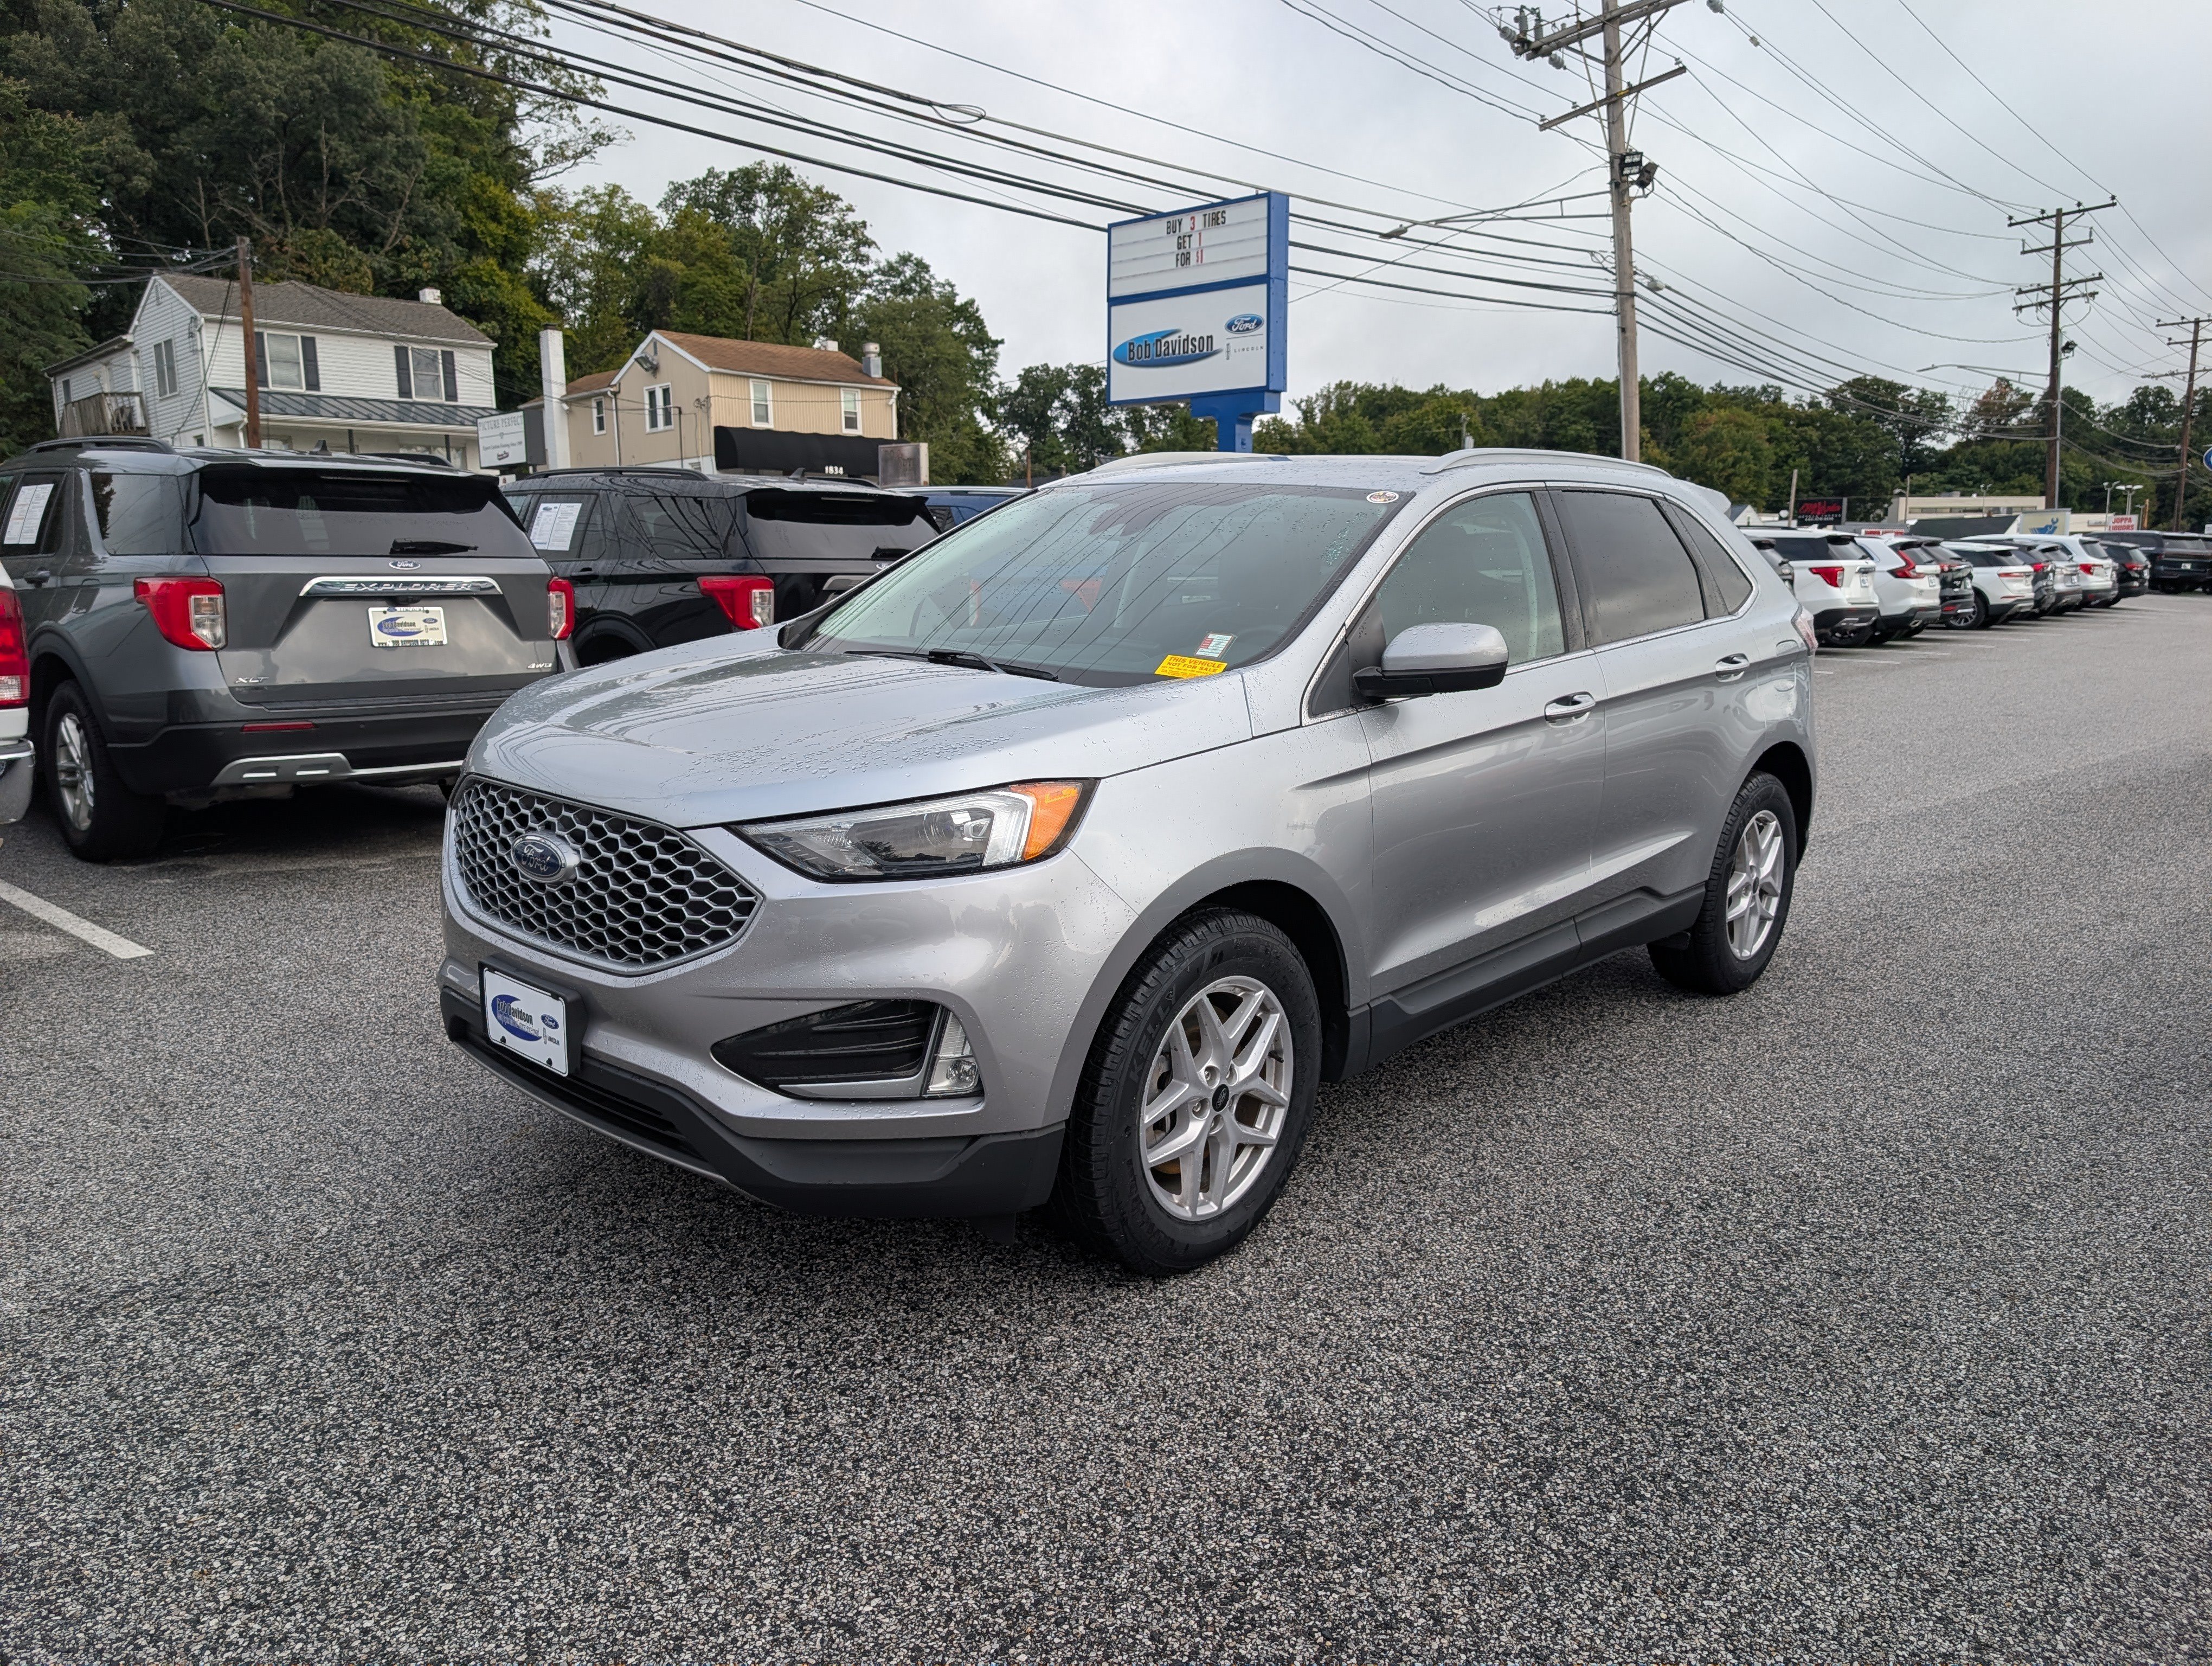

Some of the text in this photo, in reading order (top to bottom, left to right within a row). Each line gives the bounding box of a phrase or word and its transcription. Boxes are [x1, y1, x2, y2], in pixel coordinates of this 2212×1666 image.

[1166, 210, 1226, 235] BUY 3 TIRES
[1177, 232, 1202, 250] GET 1
[1175, 251, 1191, 267] FOR
[1231, 317, 1257, 331] Ford
[1128, 334, 1214, 362] Bob Davidson
[825, 465, 844, 475] 1834
[339, 582, 471, 591] EXPLORER
[1189, 659, 1224, 669] VEHICLE
[520, 844, 551, 872] Ford
[497, 998, 507, 1015] Bob
[508, 1003, 533, 1025] Davidson
[544, 1016, 556, 1028] Ford
[1129, 984, 1176, 1084] KELLY
